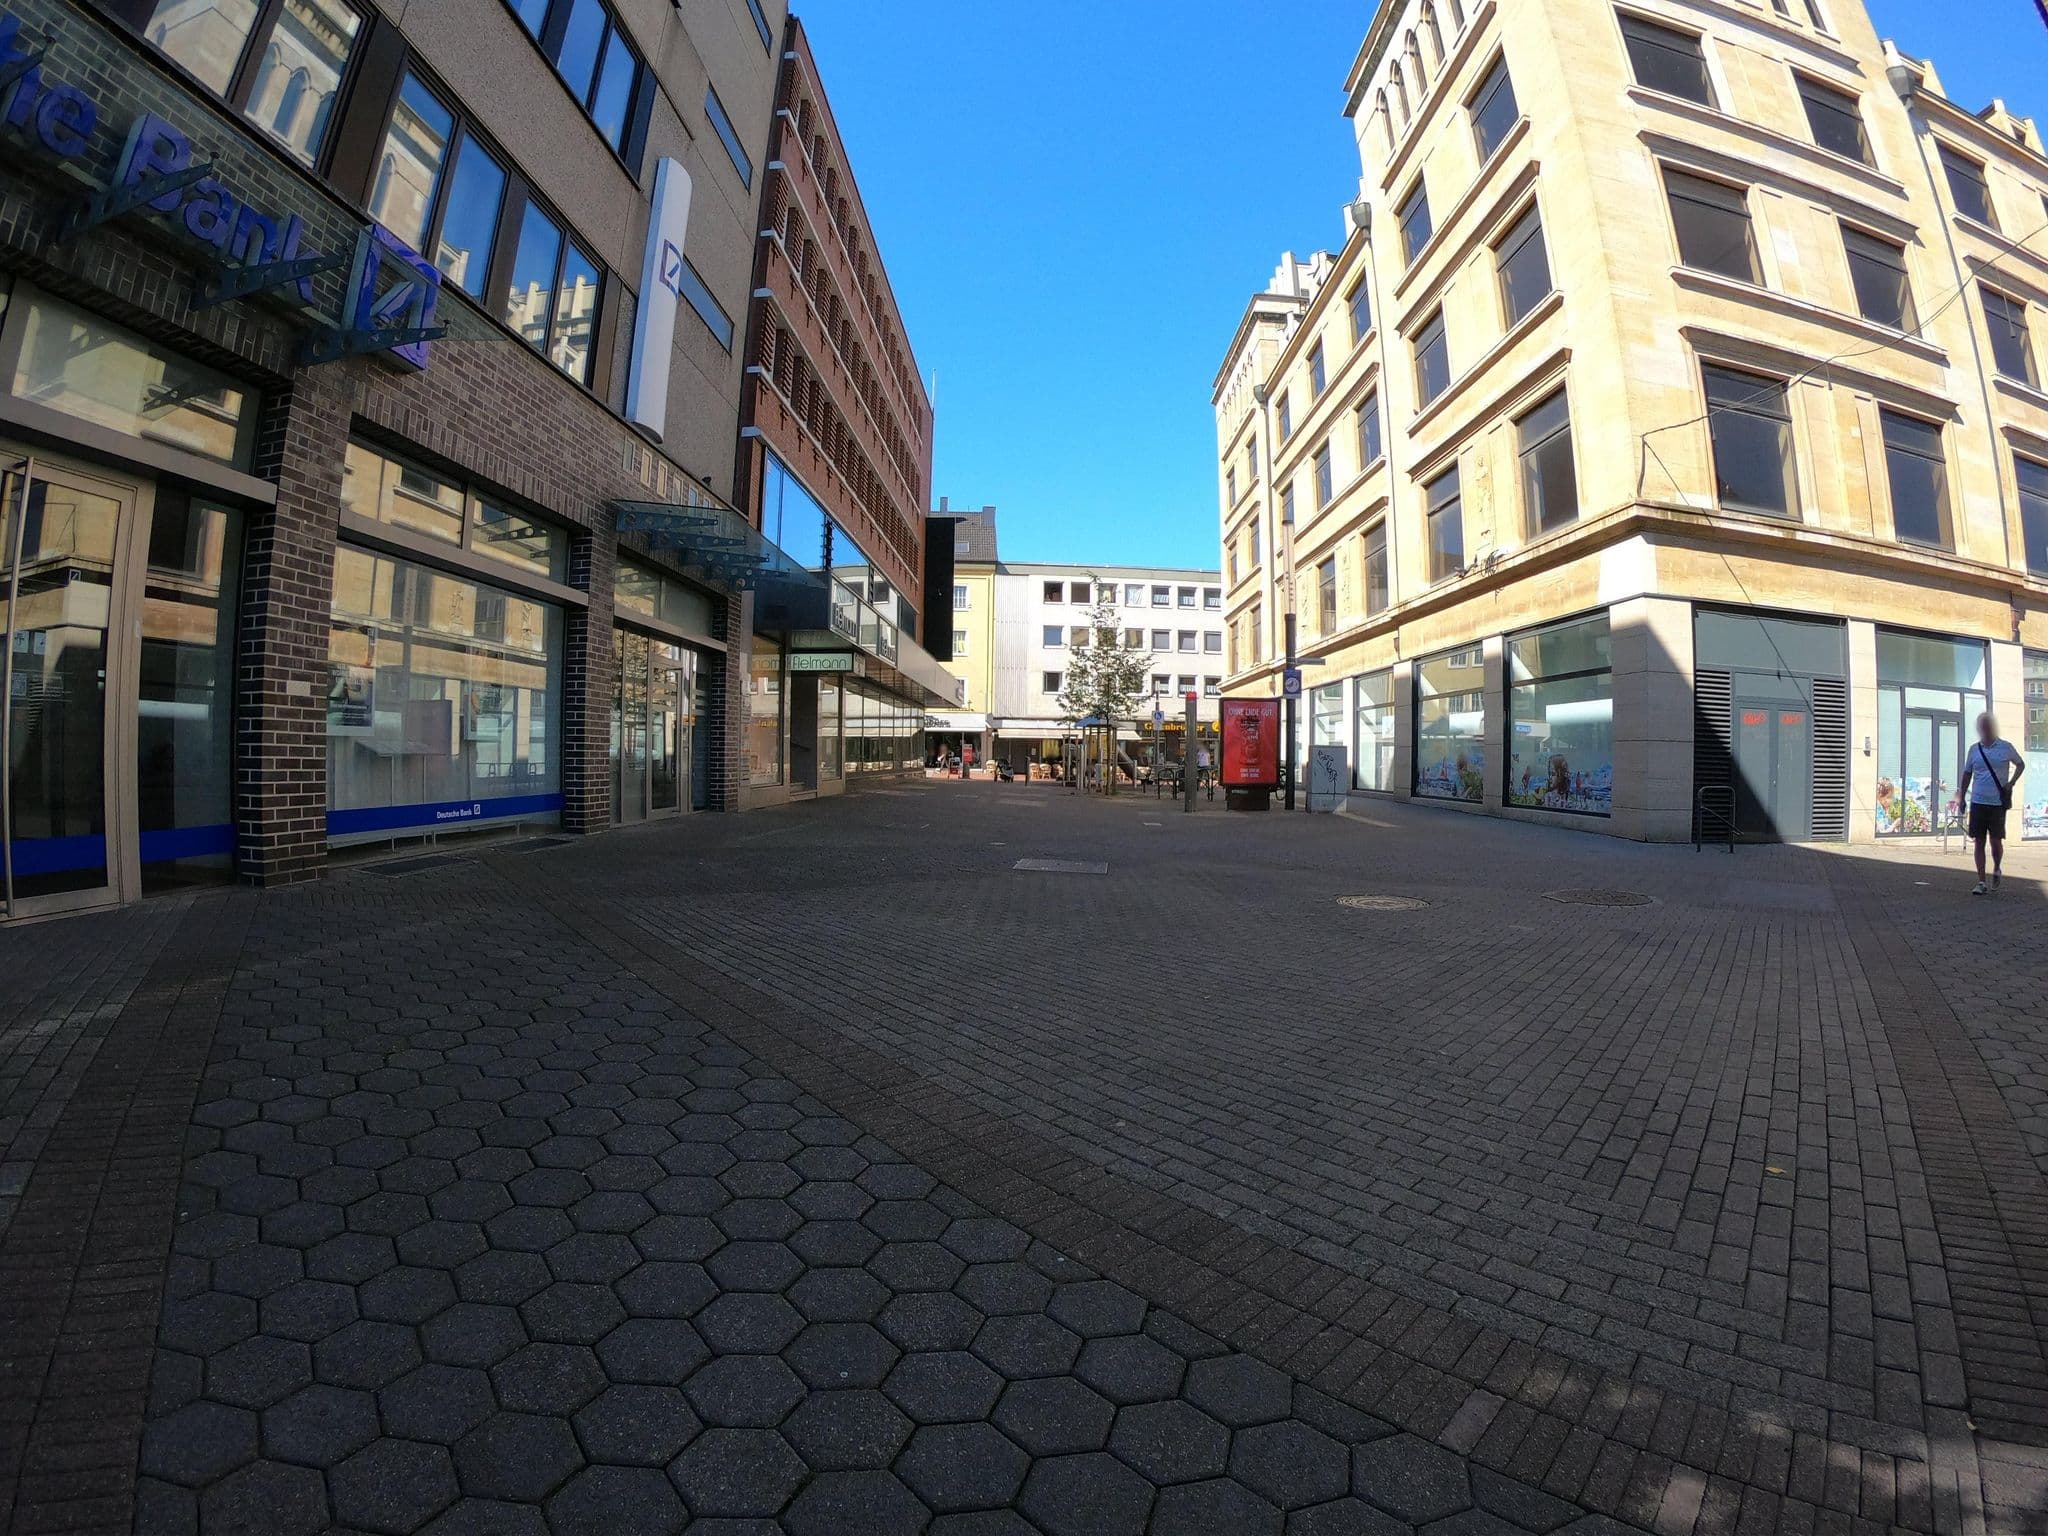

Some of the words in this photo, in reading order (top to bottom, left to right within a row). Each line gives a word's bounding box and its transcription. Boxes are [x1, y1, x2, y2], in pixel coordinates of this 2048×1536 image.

[118, 113, 325, 305] Bank
[436, 810, 459, 819] Deutsche
[460, 808, 472, 817] Bank
